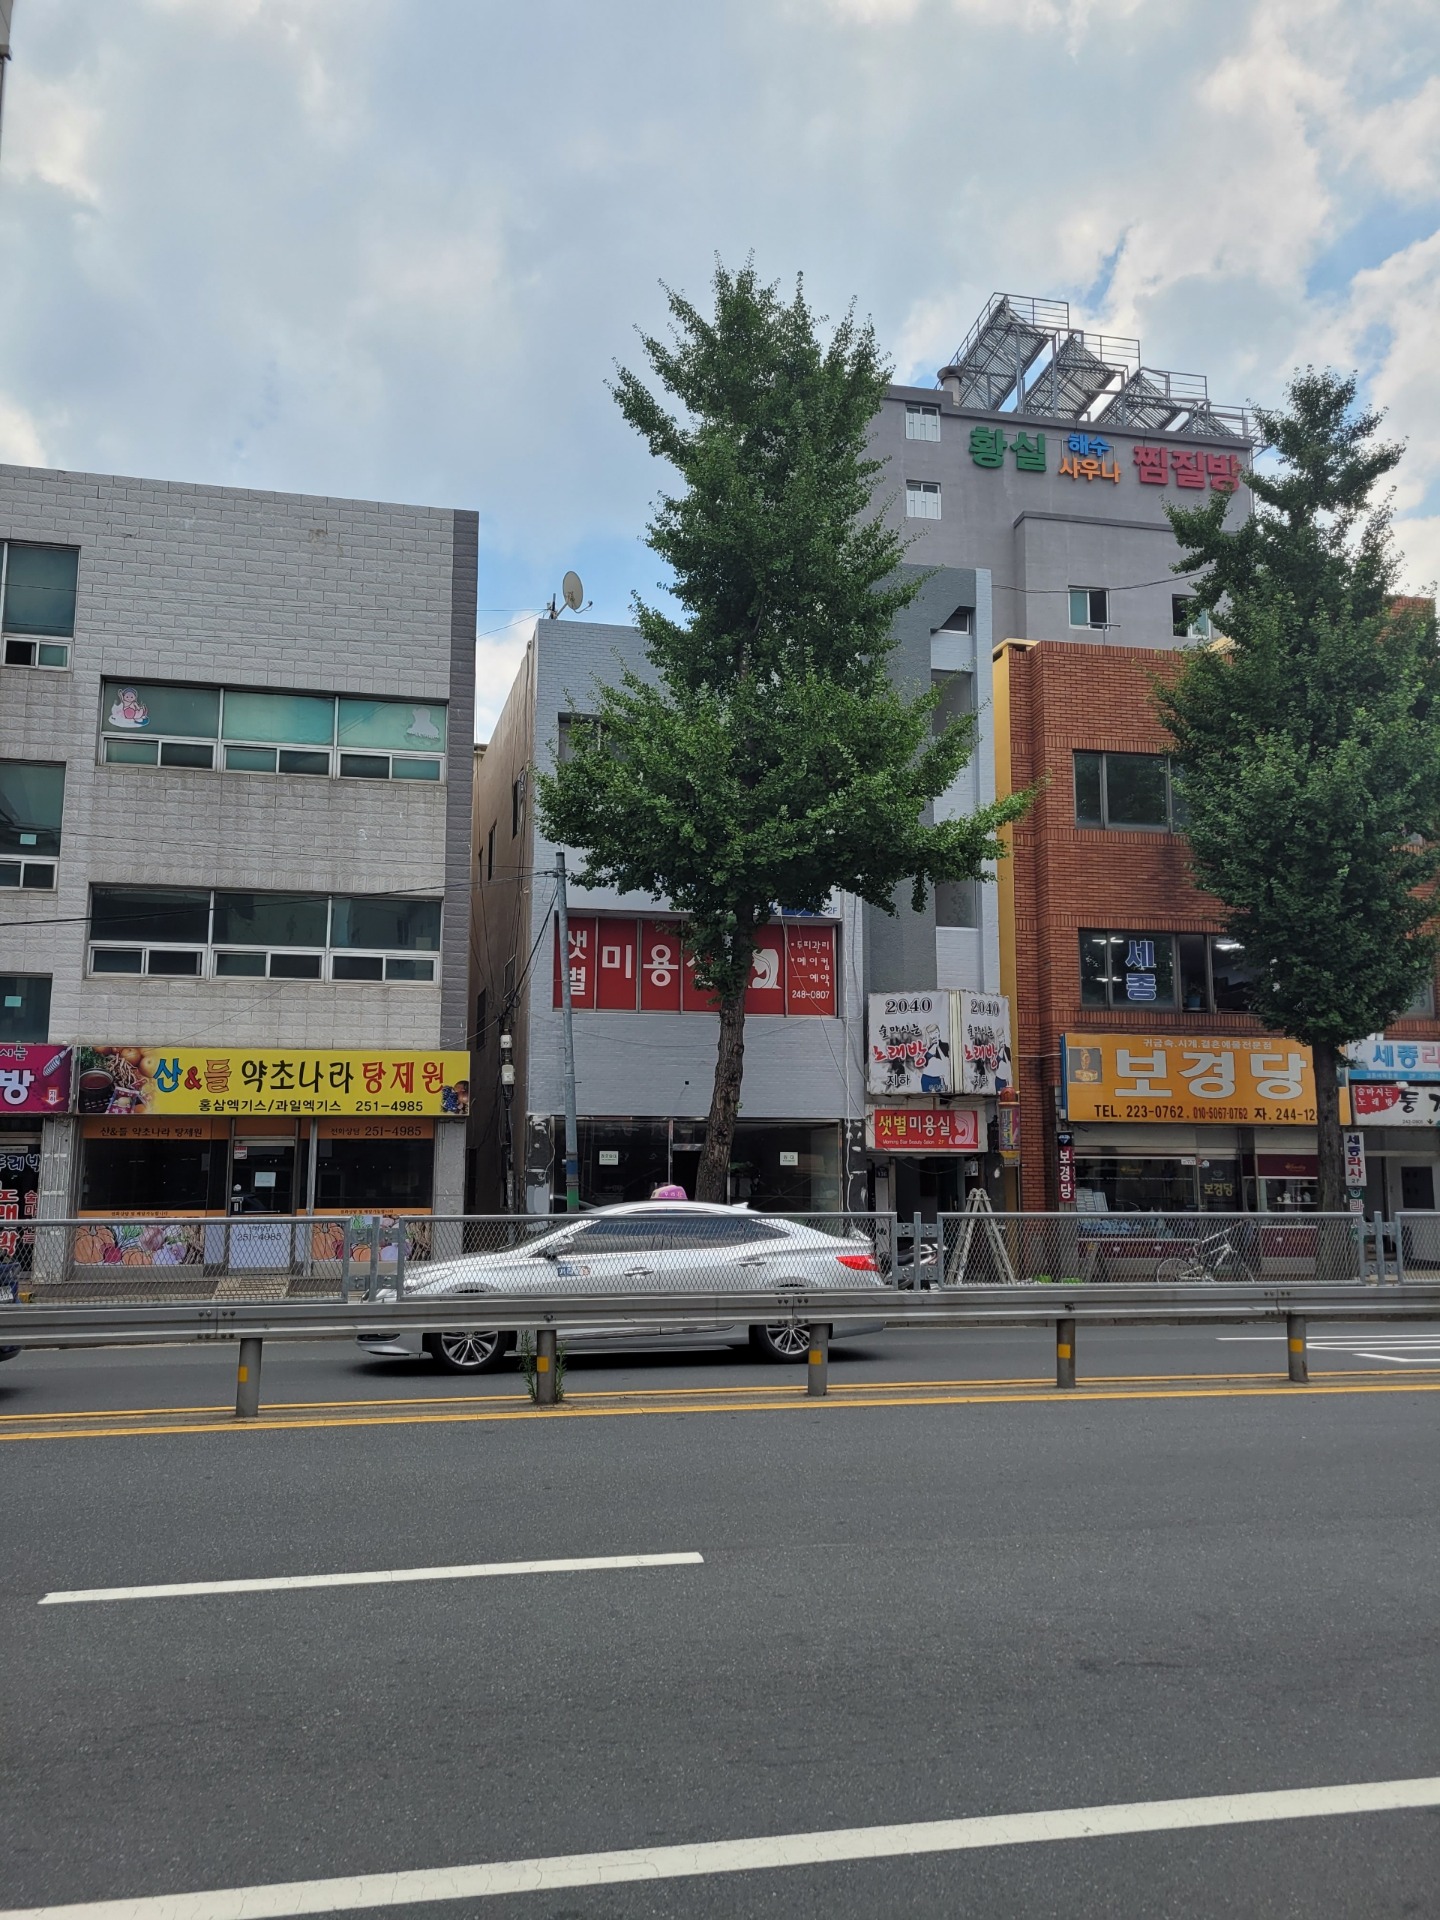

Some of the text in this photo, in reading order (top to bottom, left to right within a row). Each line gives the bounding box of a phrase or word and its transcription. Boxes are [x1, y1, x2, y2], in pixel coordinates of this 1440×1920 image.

[969, 427, 1047, 472] 황실
[1068, 433, 1110, 456] 해수
[1059, 457, 1121, 483] 사우나
[1134, 446, 1242, 492] 찜질방
[1125, 940, 1157, 1000] 세종
[792, 990, 830, 999] 248-0807
[885, 998, 932, 1014] 2040
[971, 999, 999, 1017] 2040
[879, 1024, 922, 1040] 술마시는
[873, 1040, 927, 1068] 노래방
[964, 1043, 998, 1070] 노래방
[153, 1058, 445, 1095] 산&들 약초나라 탕제원
[886, 1074, 911, 1088] 지하
[1114, 1049, 1308, 1100] 보경당
[199, 1099, 424, 1113] 홍삼엑기스/과일엑기스 251-4985
[1094, 1104, 1122, 1118] TEL.
[1193, 1106, 1248, 1120] 010-5067-0762
[1275, 1108, 1317, 1121] 244-12
[364, 1126, 422, 1137] 251-4985
[1059, 1150, 1072, 1199] 보경당
[1204, 1182, 1234, 1197] 보경당
